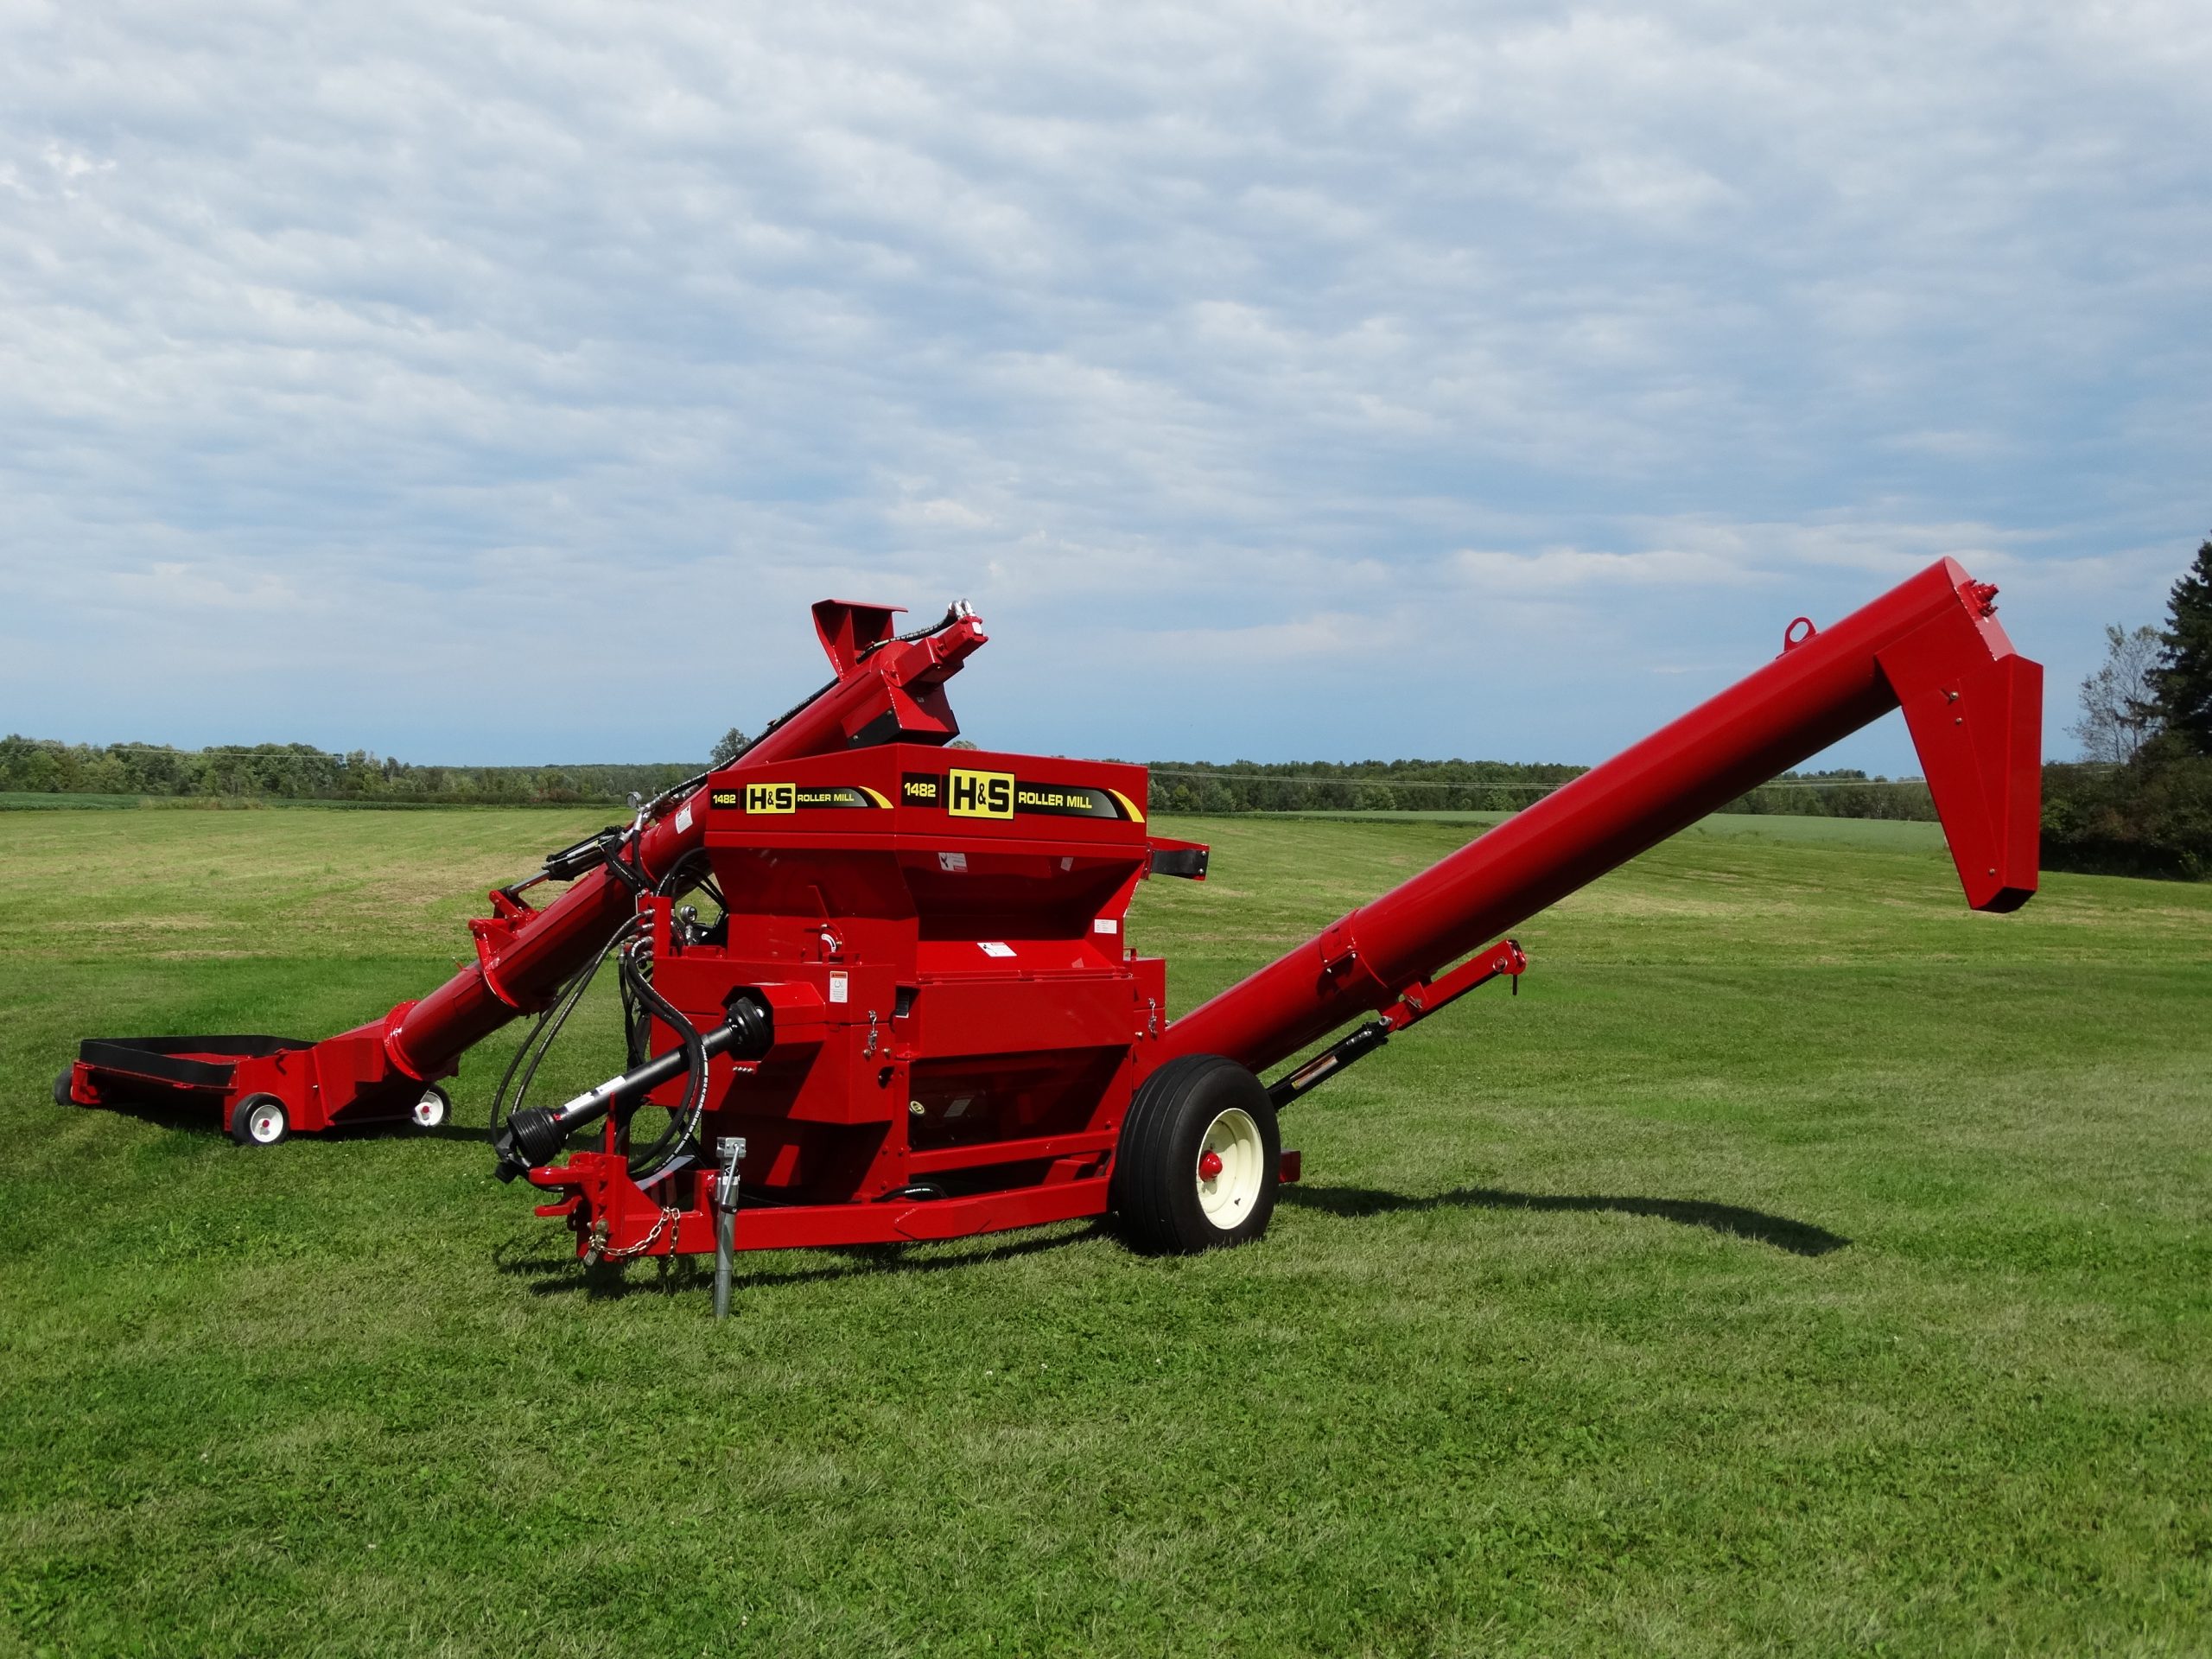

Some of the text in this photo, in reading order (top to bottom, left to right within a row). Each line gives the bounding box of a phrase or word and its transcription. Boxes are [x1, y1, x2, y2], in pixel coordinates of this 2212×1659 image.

[713, 788, 854, 810] 1482 H&S ROLLER MILL
[904, 776, 1092, 813] 1482 H&S ROLLER MILL
